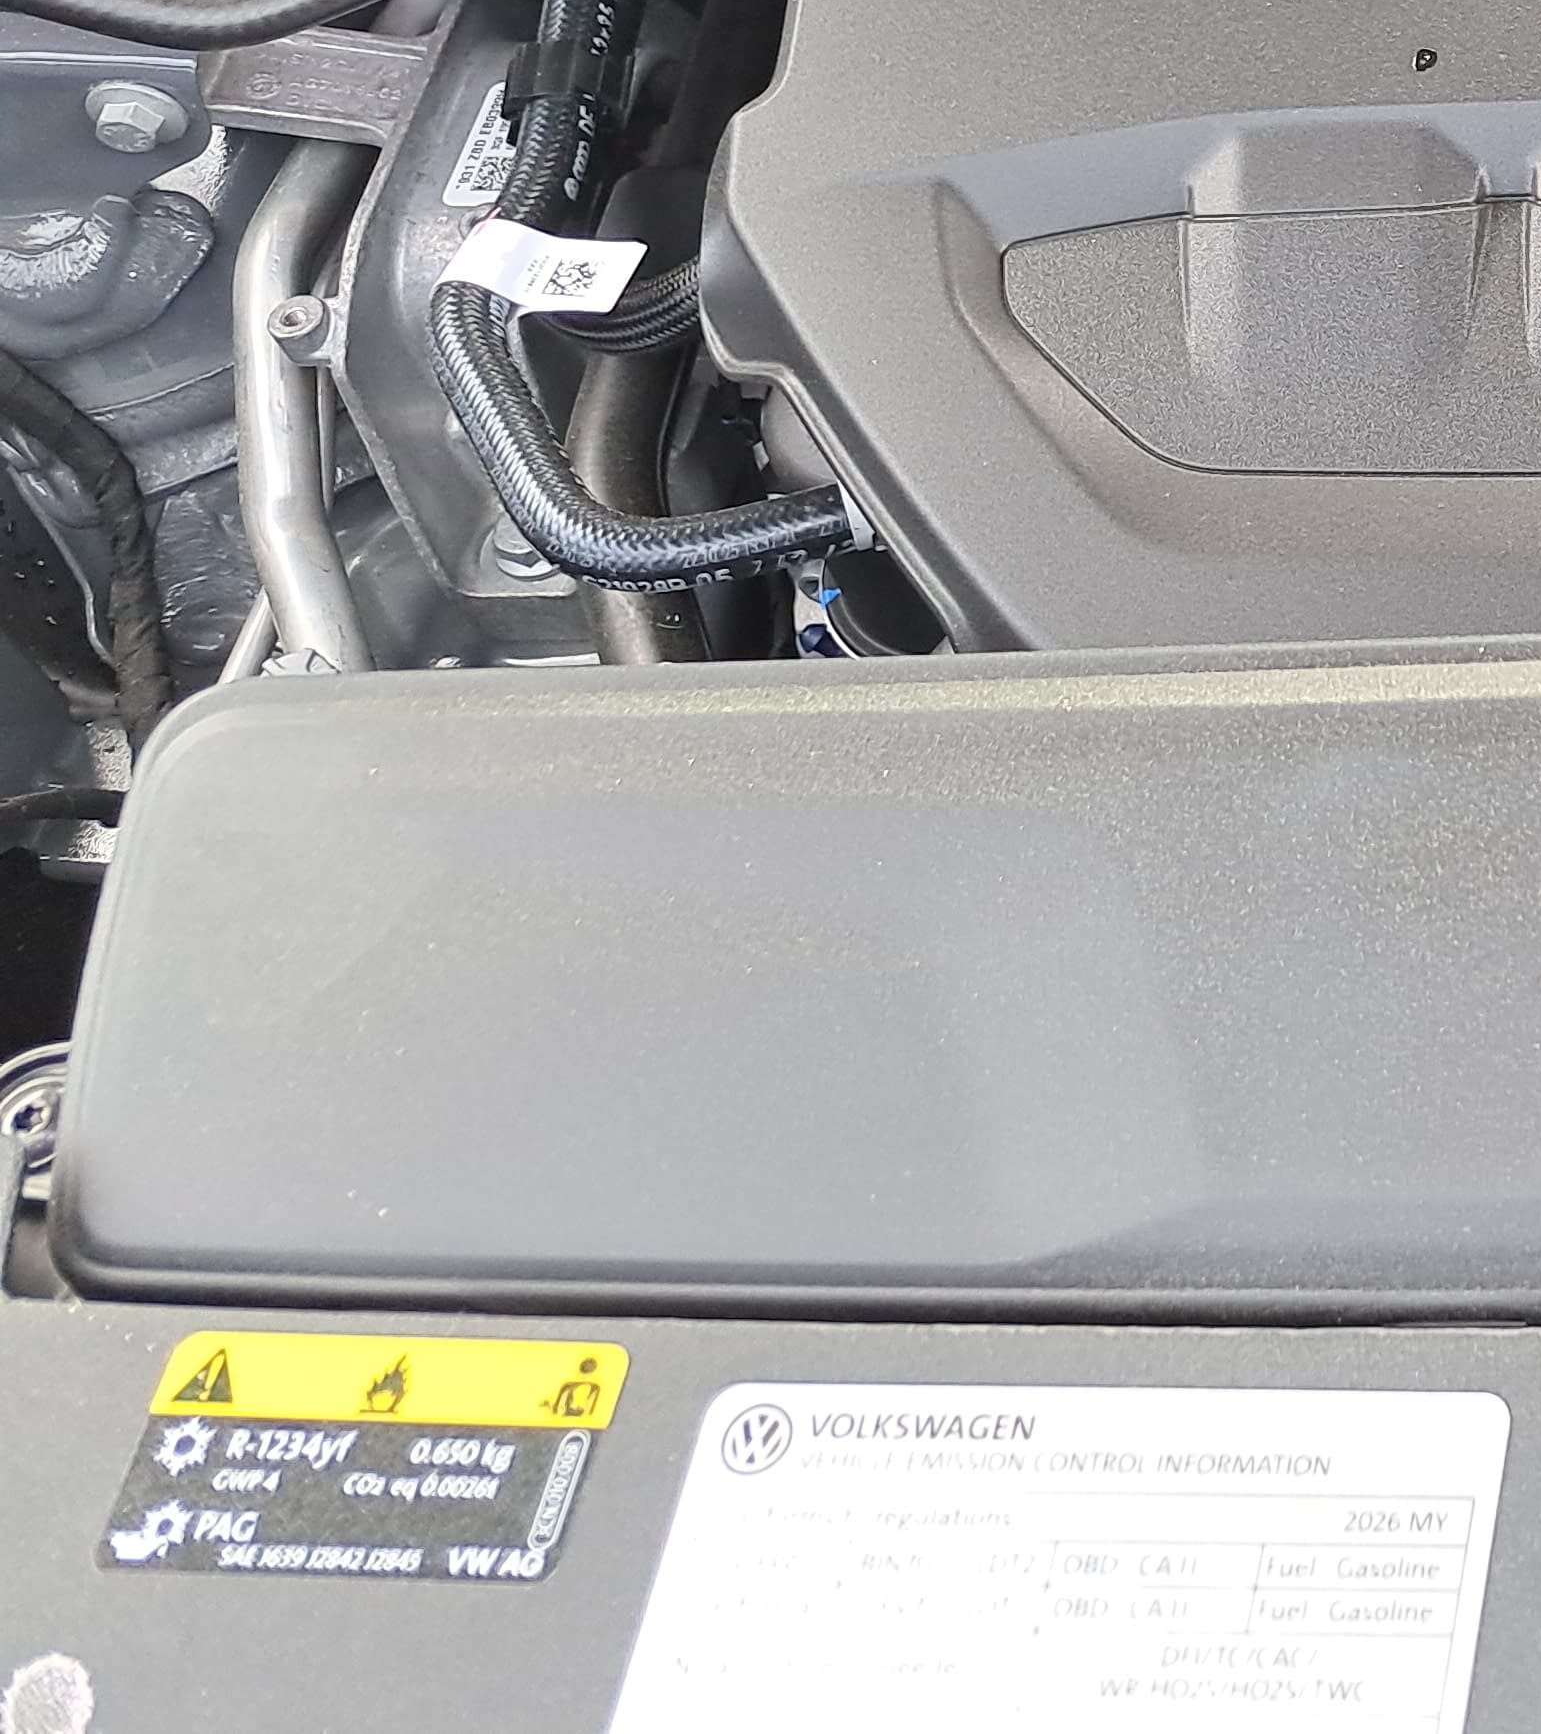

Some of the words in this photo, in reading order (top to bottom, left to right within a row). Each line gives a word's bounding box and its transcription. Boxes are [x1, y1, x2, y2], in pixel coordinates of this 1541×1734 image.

[811, 1412, 1037, 1442] VOLKSWAGEN
[226, 1428, 359, 1470] R-1234yf
[410, 1437, 482, 1466] 0.650
[1156, 1452, 1332, 1477] INFORMATION
[212, 1468, 264, 1492] GWP
[193, 1510, 260, 1541] PAG
[1343, 1510, 1401, 1534] 2026
[1408, 1511, 1449, 1533] MY
[448, 1545, 501, 1576] VW
[497, 1545, 546, 1577] AG
[1336, 1556, 1441, 1580] Gasoline
[1328, 1599, 1433, 1625] Gasoline
